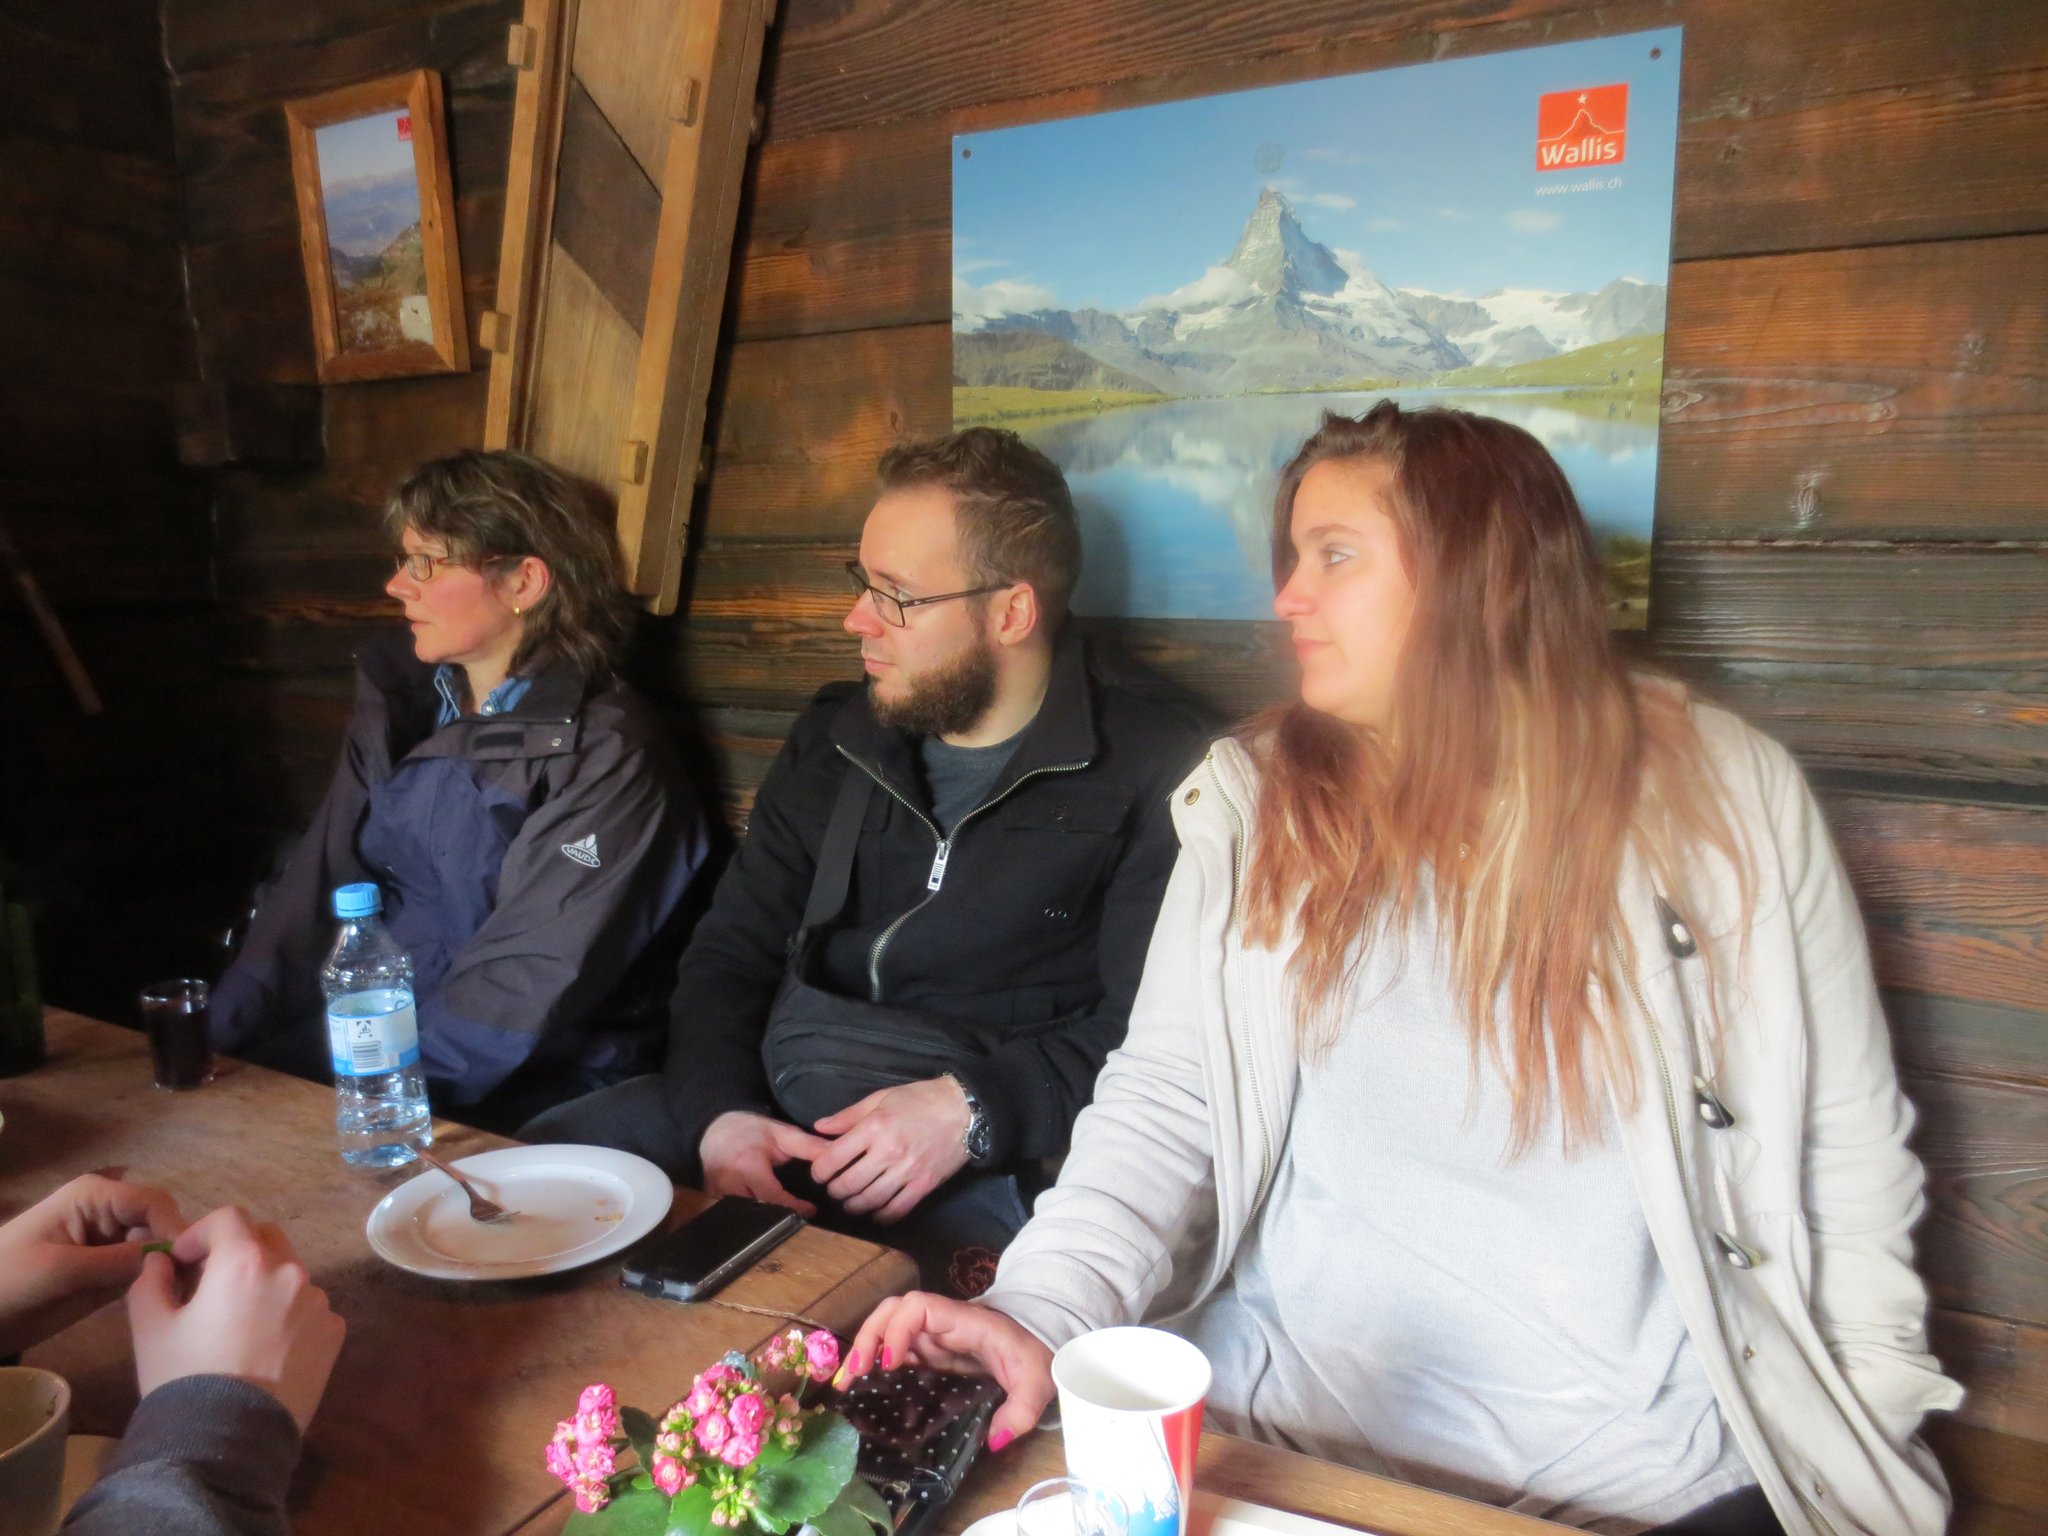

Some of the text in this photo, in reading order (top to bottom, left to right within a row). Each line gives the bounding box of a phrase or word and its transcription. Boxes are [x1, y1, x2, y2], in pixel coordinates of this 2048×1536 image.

[1541, 137, 1617, 166] Wallis
[1536, 176, 1622, 196] www.wallis.ch
[566, 846, 598, 866] VAUDE
